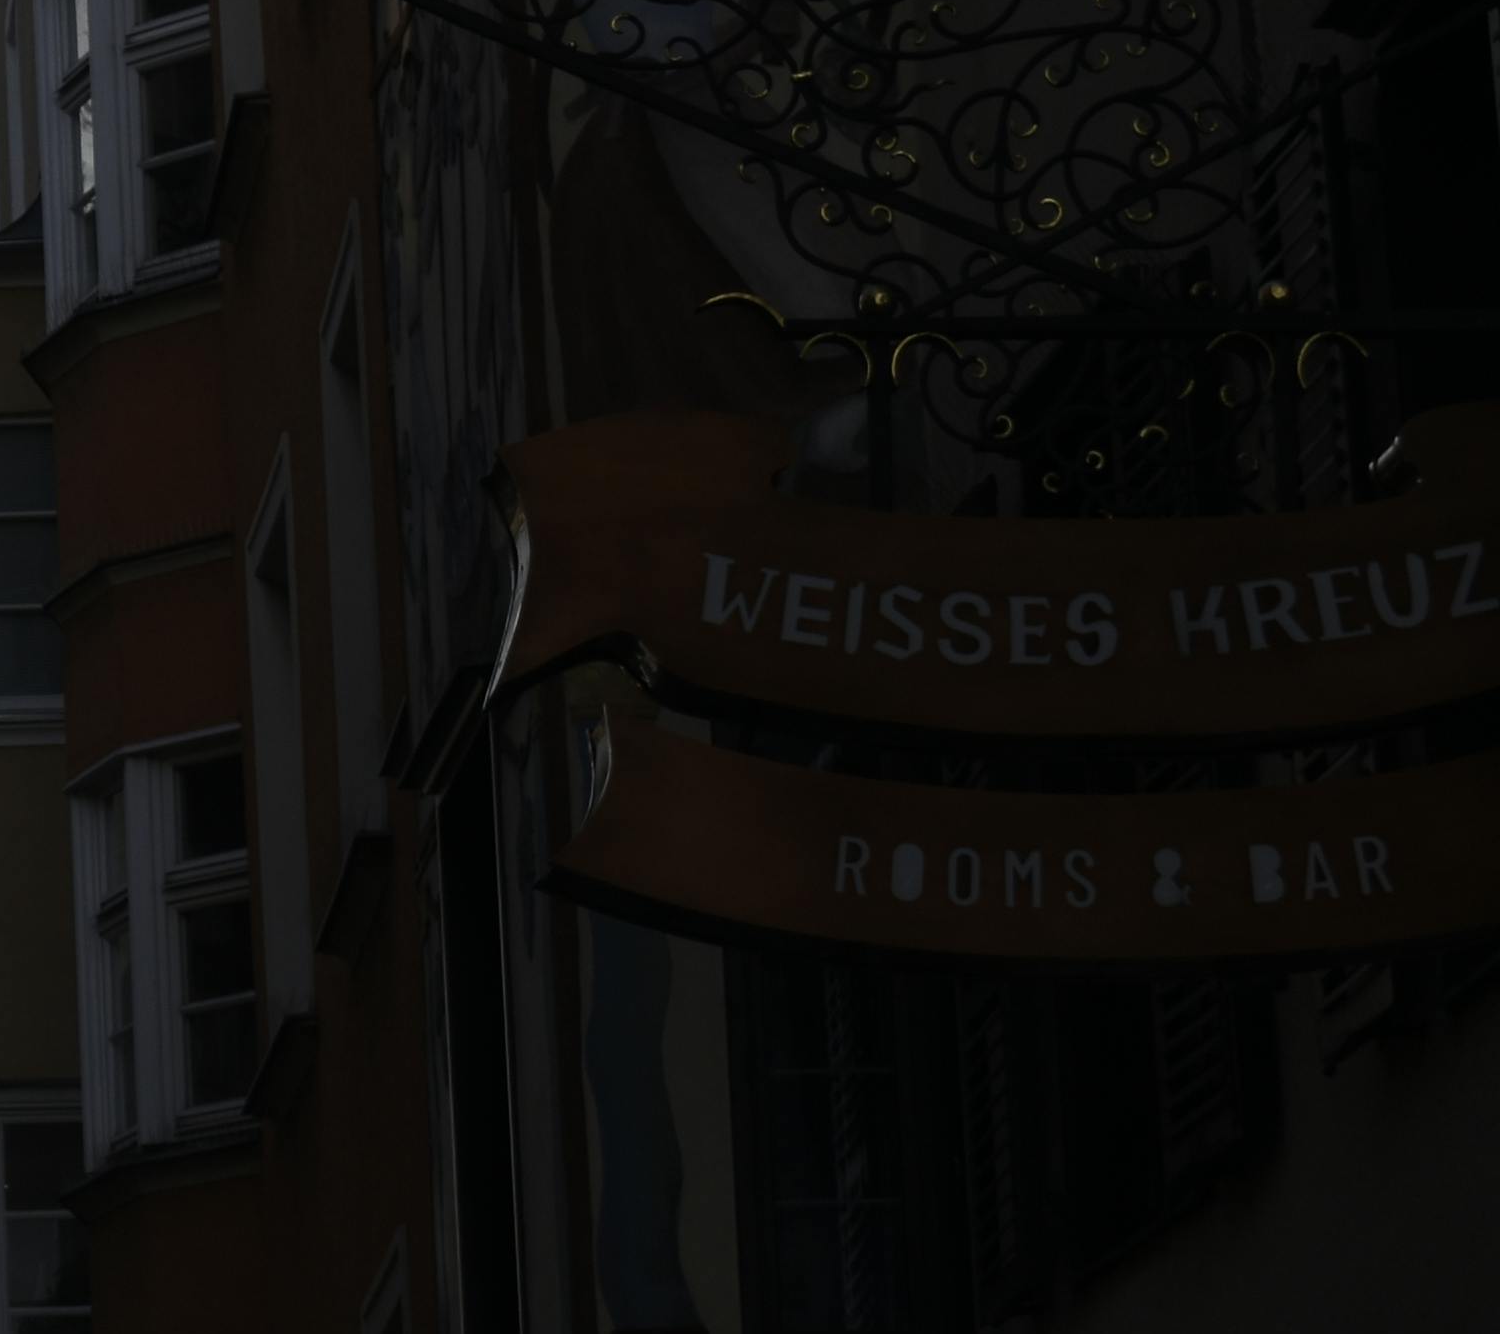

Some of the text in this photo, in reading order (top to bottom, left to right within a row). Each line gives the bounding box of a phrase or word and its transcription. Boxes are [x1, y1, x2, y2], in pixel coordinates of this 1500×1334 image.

[701, 540, 1500, 667] WEISSES KREUZ
[835, 833, 1397, 909] ROOMS & BAR
